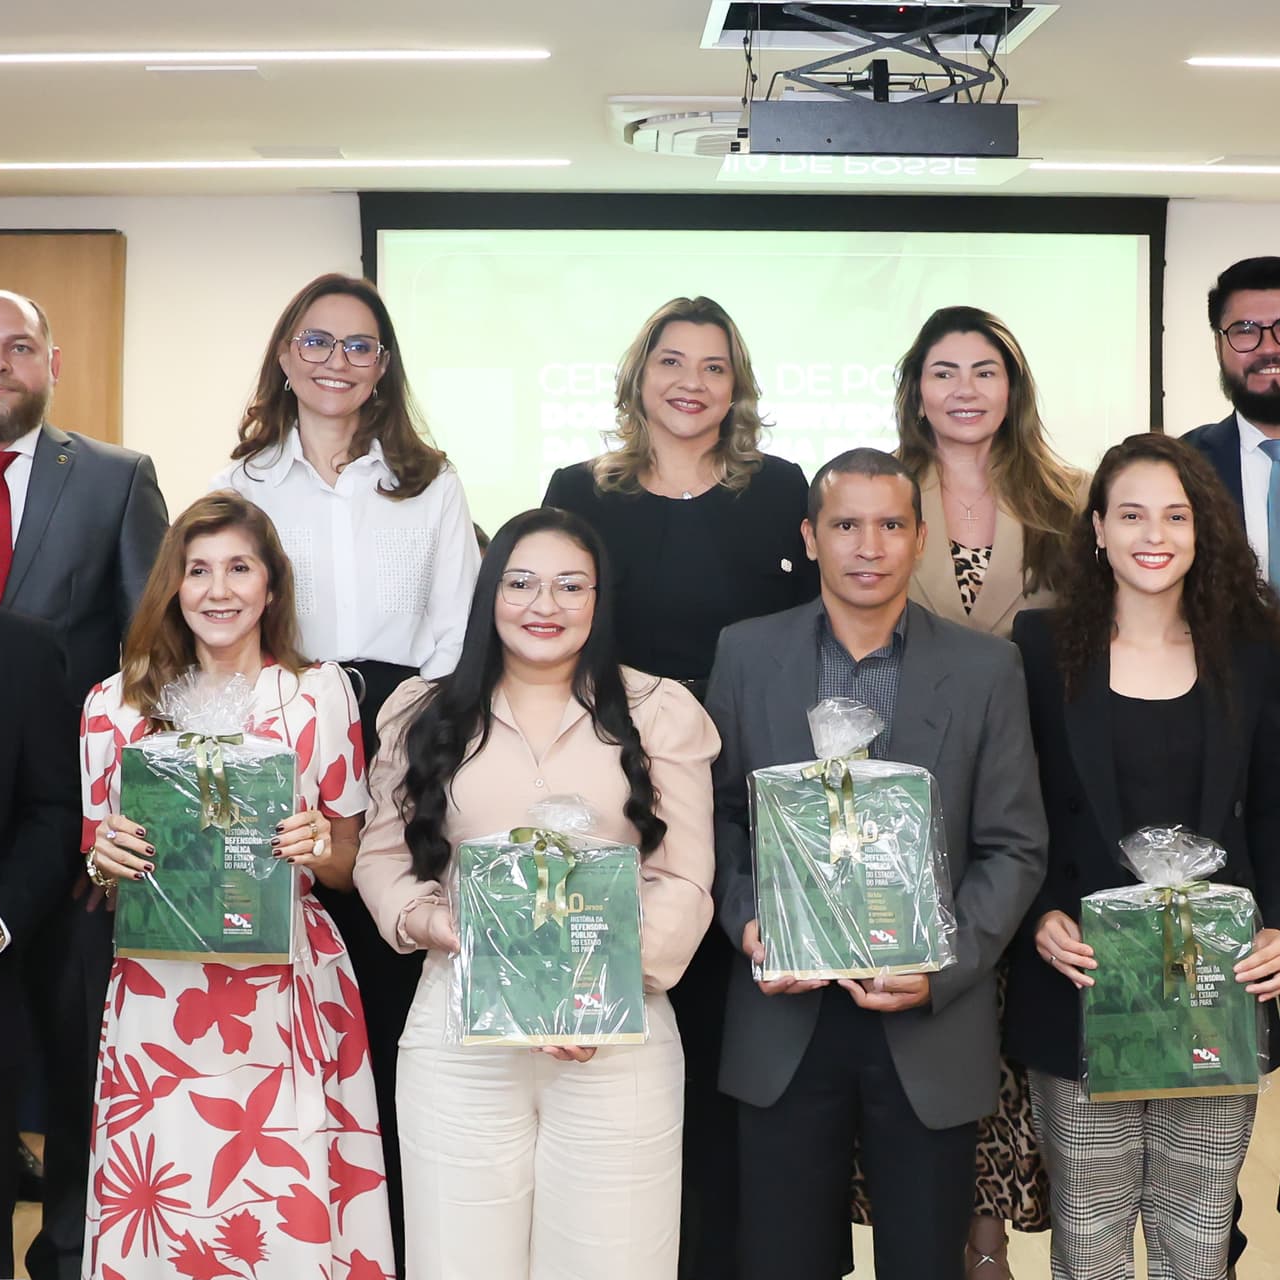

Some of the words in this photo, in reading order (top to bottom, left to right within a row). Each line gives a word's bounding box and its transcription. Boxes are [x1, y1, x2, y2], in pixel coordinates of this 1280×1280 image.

[841, 363, 896, 396] PO
[225, 837, 263, 845] DEFENSORIA
[571, 923, 609, 931] DEFENSORIA
[571, 930, 598, 939] PÚBLICA
